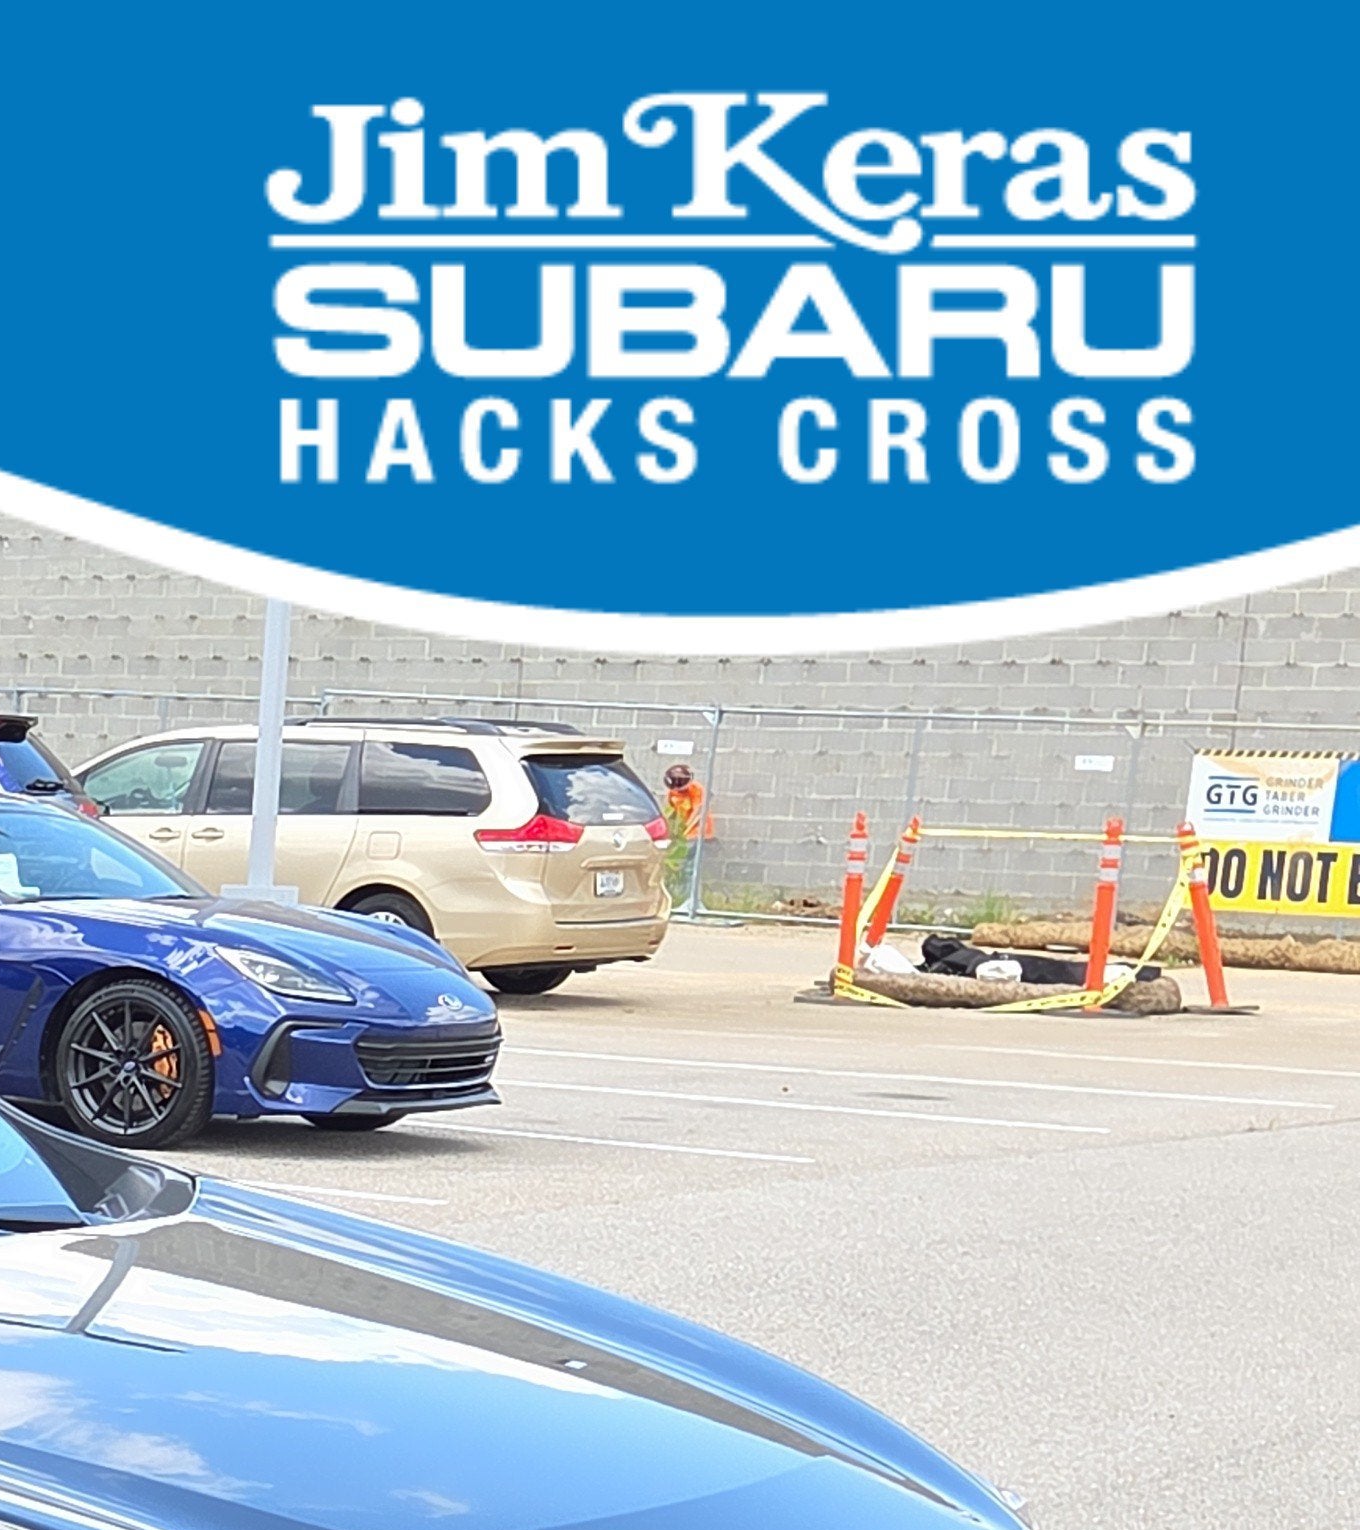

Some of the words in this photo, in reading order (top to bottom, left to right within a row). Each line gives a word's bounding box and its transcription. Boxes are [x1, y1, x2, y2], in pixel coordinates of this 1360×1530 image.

[1266, 776, 1323, 790] GRINDER
[1206, 784, 1258, 806] GTG
[1265, 789, 1306, 803] TABER
[1262, 804, 1320, 817] GRINDER
[1257, 849, 1338, 903] NOT
